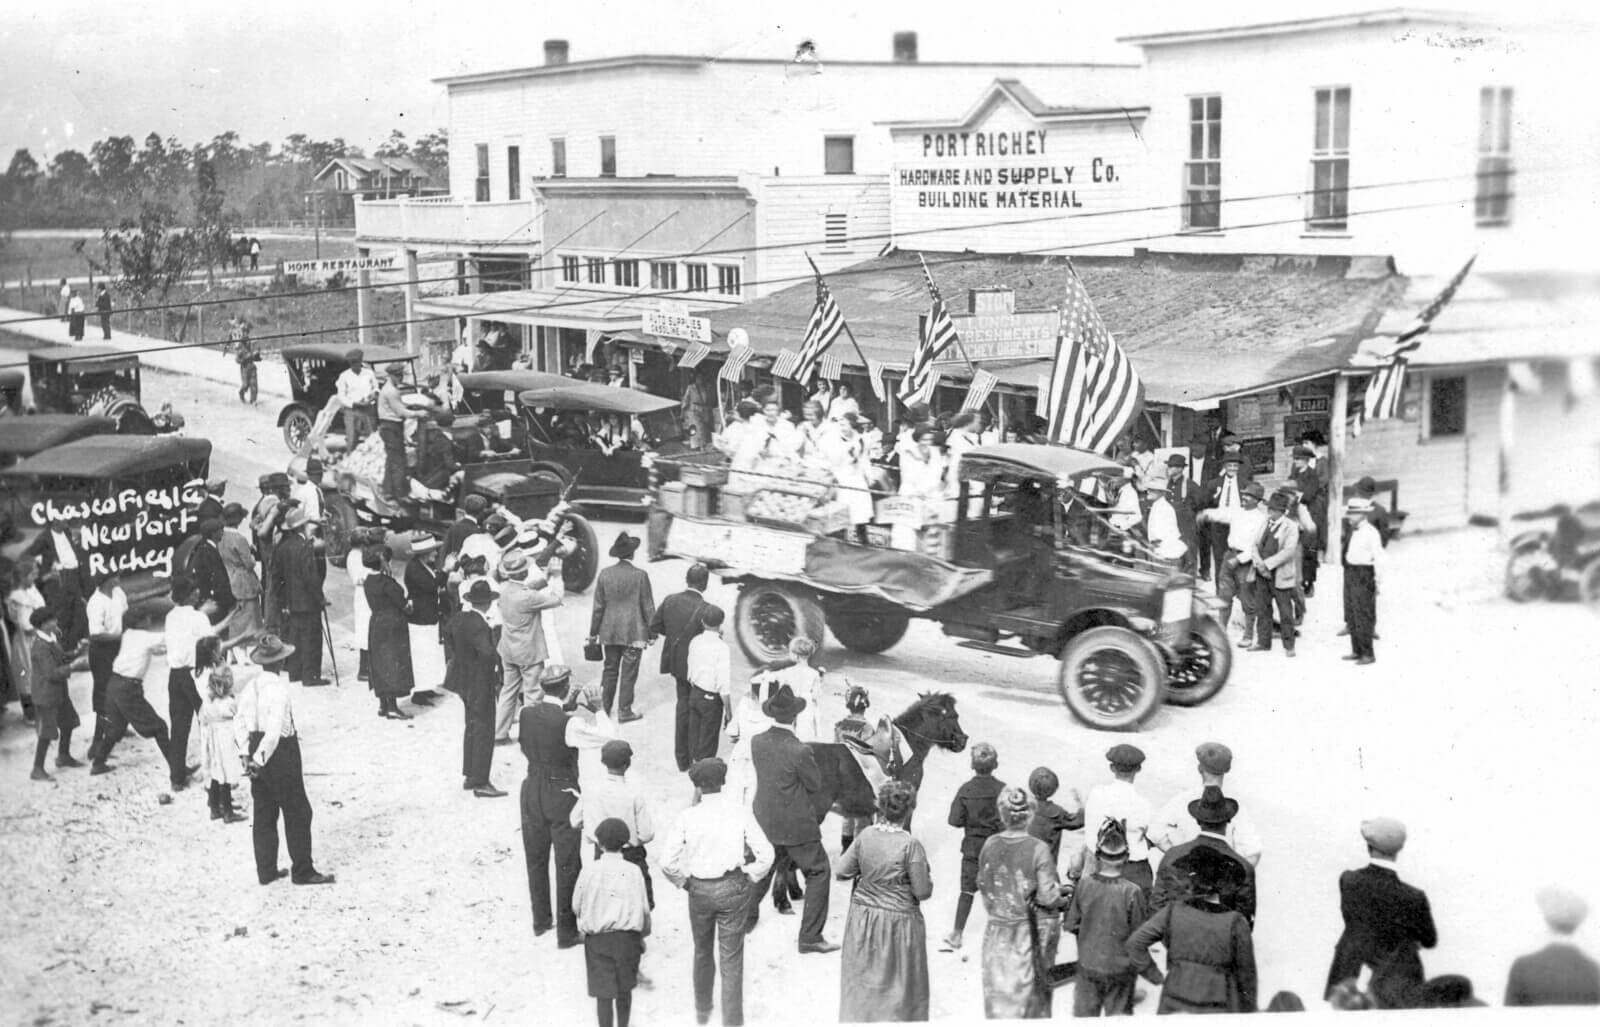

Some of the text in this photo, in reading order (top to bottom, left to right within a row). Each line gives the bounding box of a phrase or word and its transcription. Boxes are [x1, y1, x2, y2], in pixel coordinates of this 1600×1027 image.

[923, 129, 1048, 158] PORT RICHEY
[900, 157, 1120, 186] HARDWARE AND SUPPLY Co.
[918, 189, 1083, 209] BUILDING MATERIAL
[287, 257, 394, 272] HOME RESTAURANT
